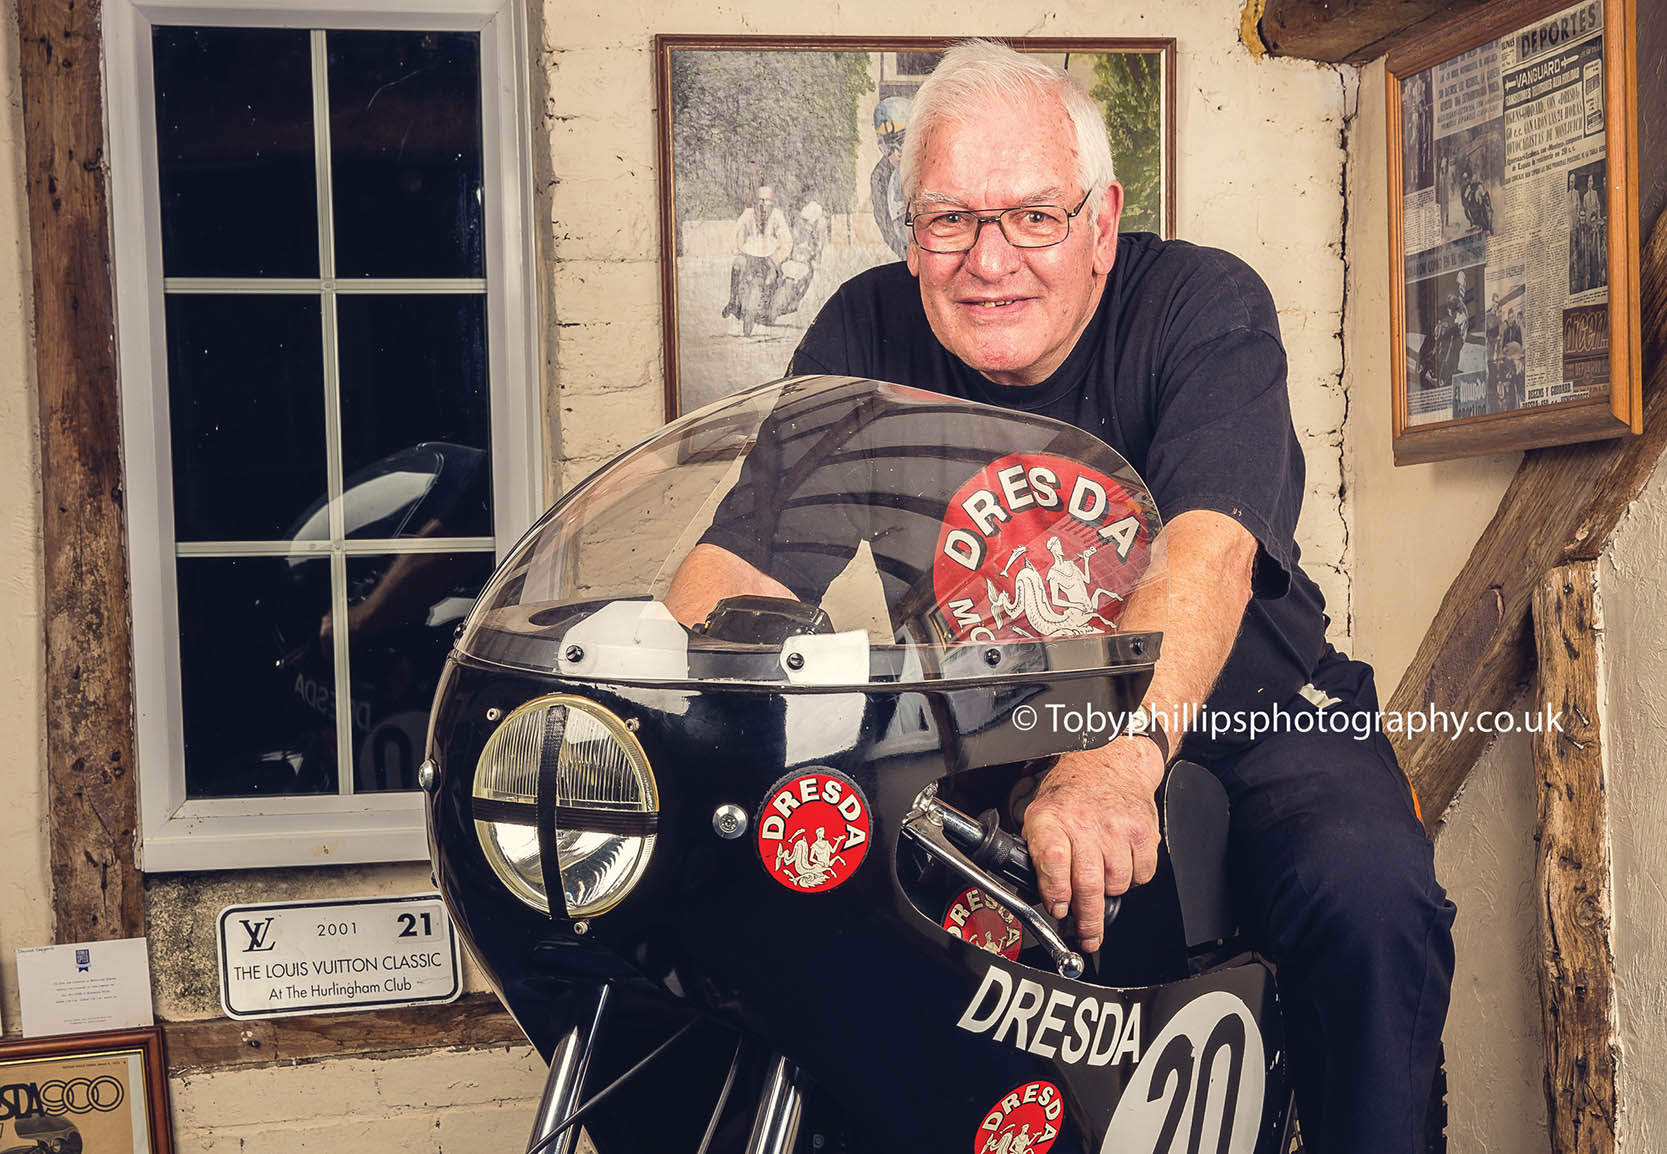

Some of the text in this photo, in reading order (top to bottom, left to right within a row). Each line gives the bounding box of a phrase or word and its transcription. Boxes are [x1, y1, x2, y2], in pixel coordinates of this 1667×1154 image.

[1521, 3, 1596, 57] DEPORTES
[1516, 58, 1561, 88] VANGUARD
[943, 463, 1141, 572] DRESDA
[762, 778, 867, 850] DRESDA
[317, 922, 358, 936] 2001
[397, 912, 433, 938] 21
[233, 952, 442, 981] THE LOUIS VUITTON CLASSIC
[269, 977, 412, 1001] At The Hurlingham Club
[956, 964, 1141, 1066] DRESDA
[1147, 1012, 1247, 1154] 20
[981, 1083, 1062, 1145] DRESDA
